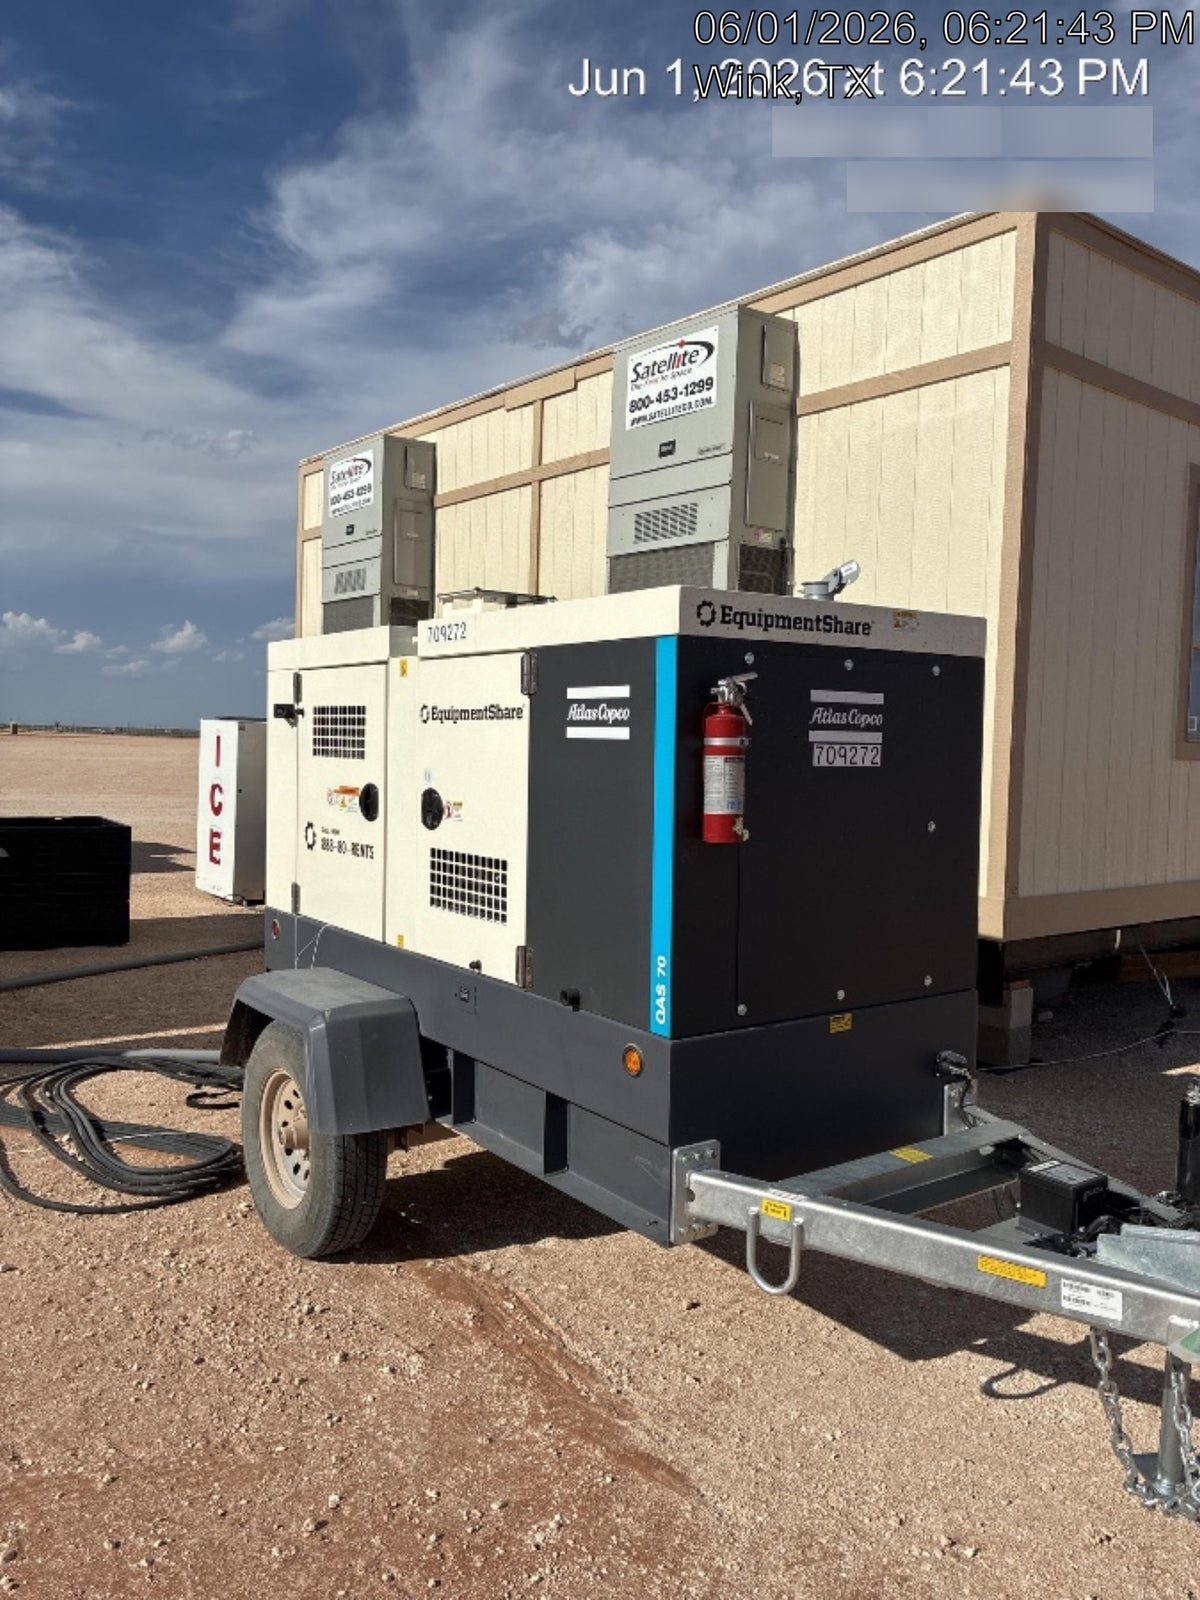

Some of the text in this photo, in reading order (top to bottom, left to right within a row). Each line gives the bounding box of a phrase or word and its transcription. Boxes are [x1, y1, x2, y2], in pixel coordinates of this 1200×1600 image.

[631, 349, 700, 383] Satellite
[629, 377, 714, 413] 800-453-1299
[427, 621, 467, 643] 709272
[720, 604, 873, 636] EquipmentShare
[431, 703, 523, 724] EquipmentShare
[815, 745, 880, 765] 709272
[655, 955, 667, 1026] QAS 70
